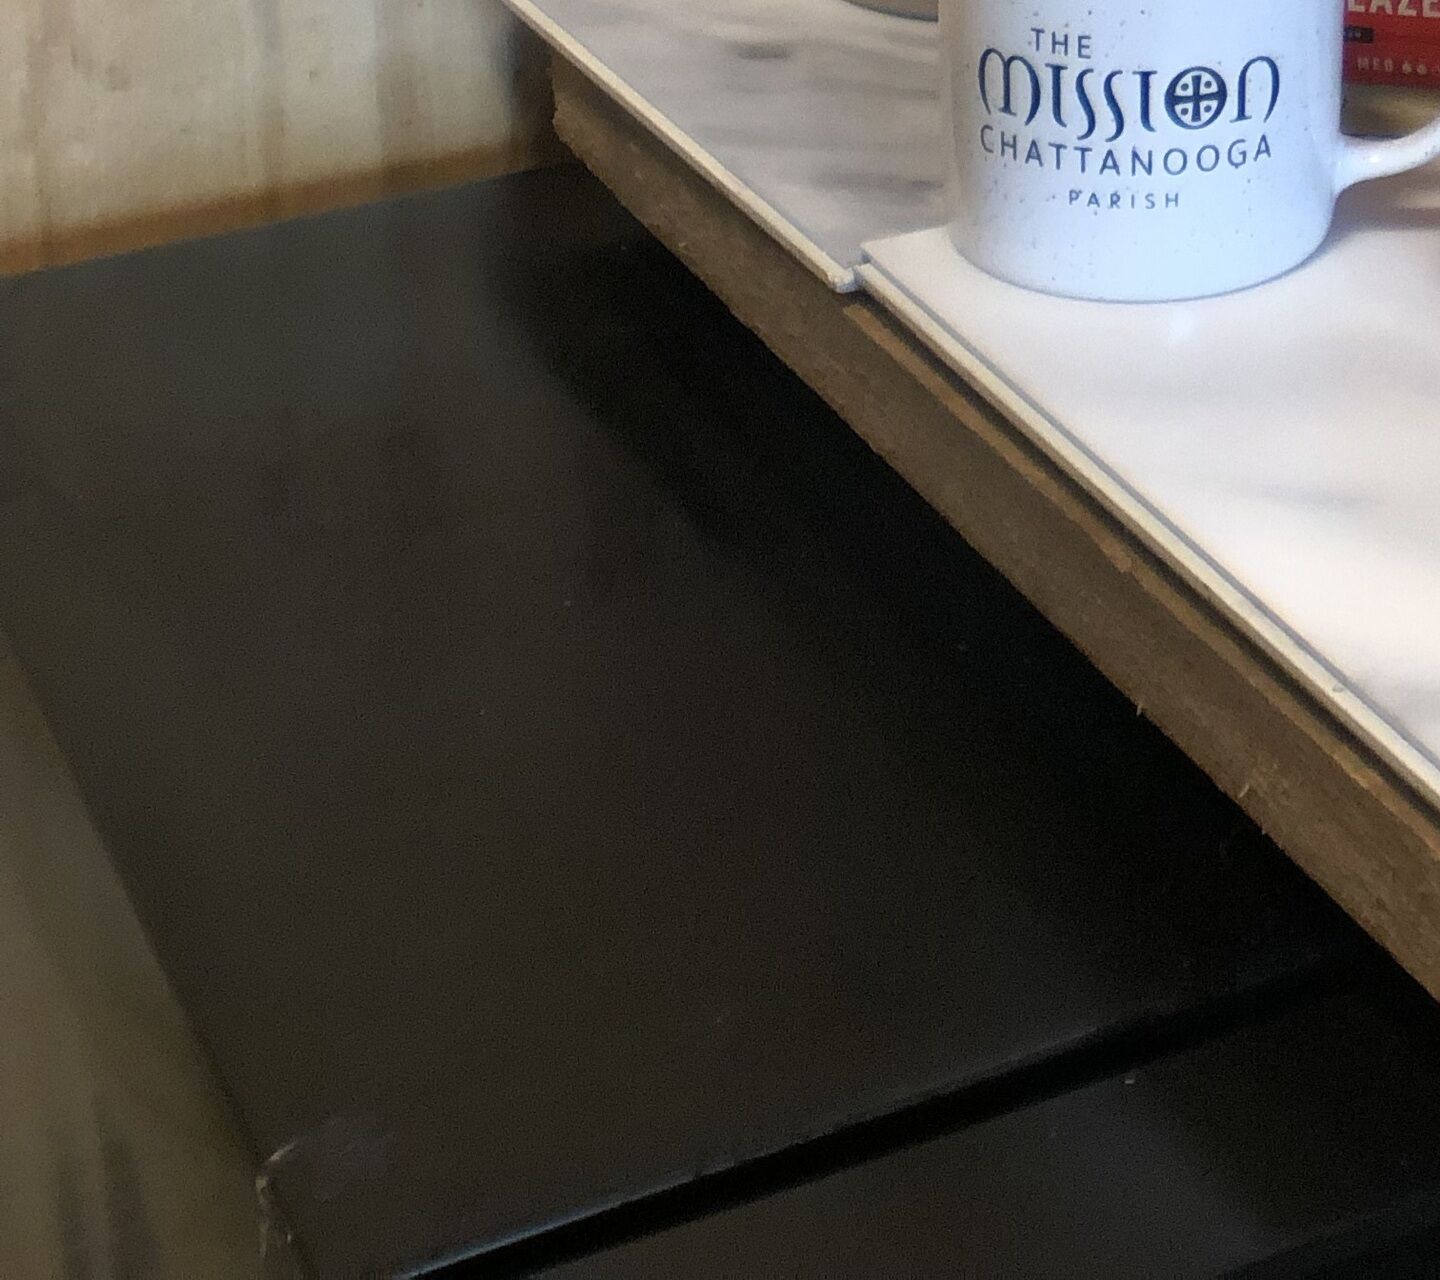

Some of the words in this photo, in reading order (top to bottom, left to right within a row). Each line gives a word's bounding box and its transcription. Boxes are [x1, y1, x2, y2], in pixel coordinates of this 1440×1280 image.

[1031, 26, 1092, 59] THE
[980, 124, 1272, 177] CHATTANOOGA
[1068, 190, 1179, 210] PARISH
